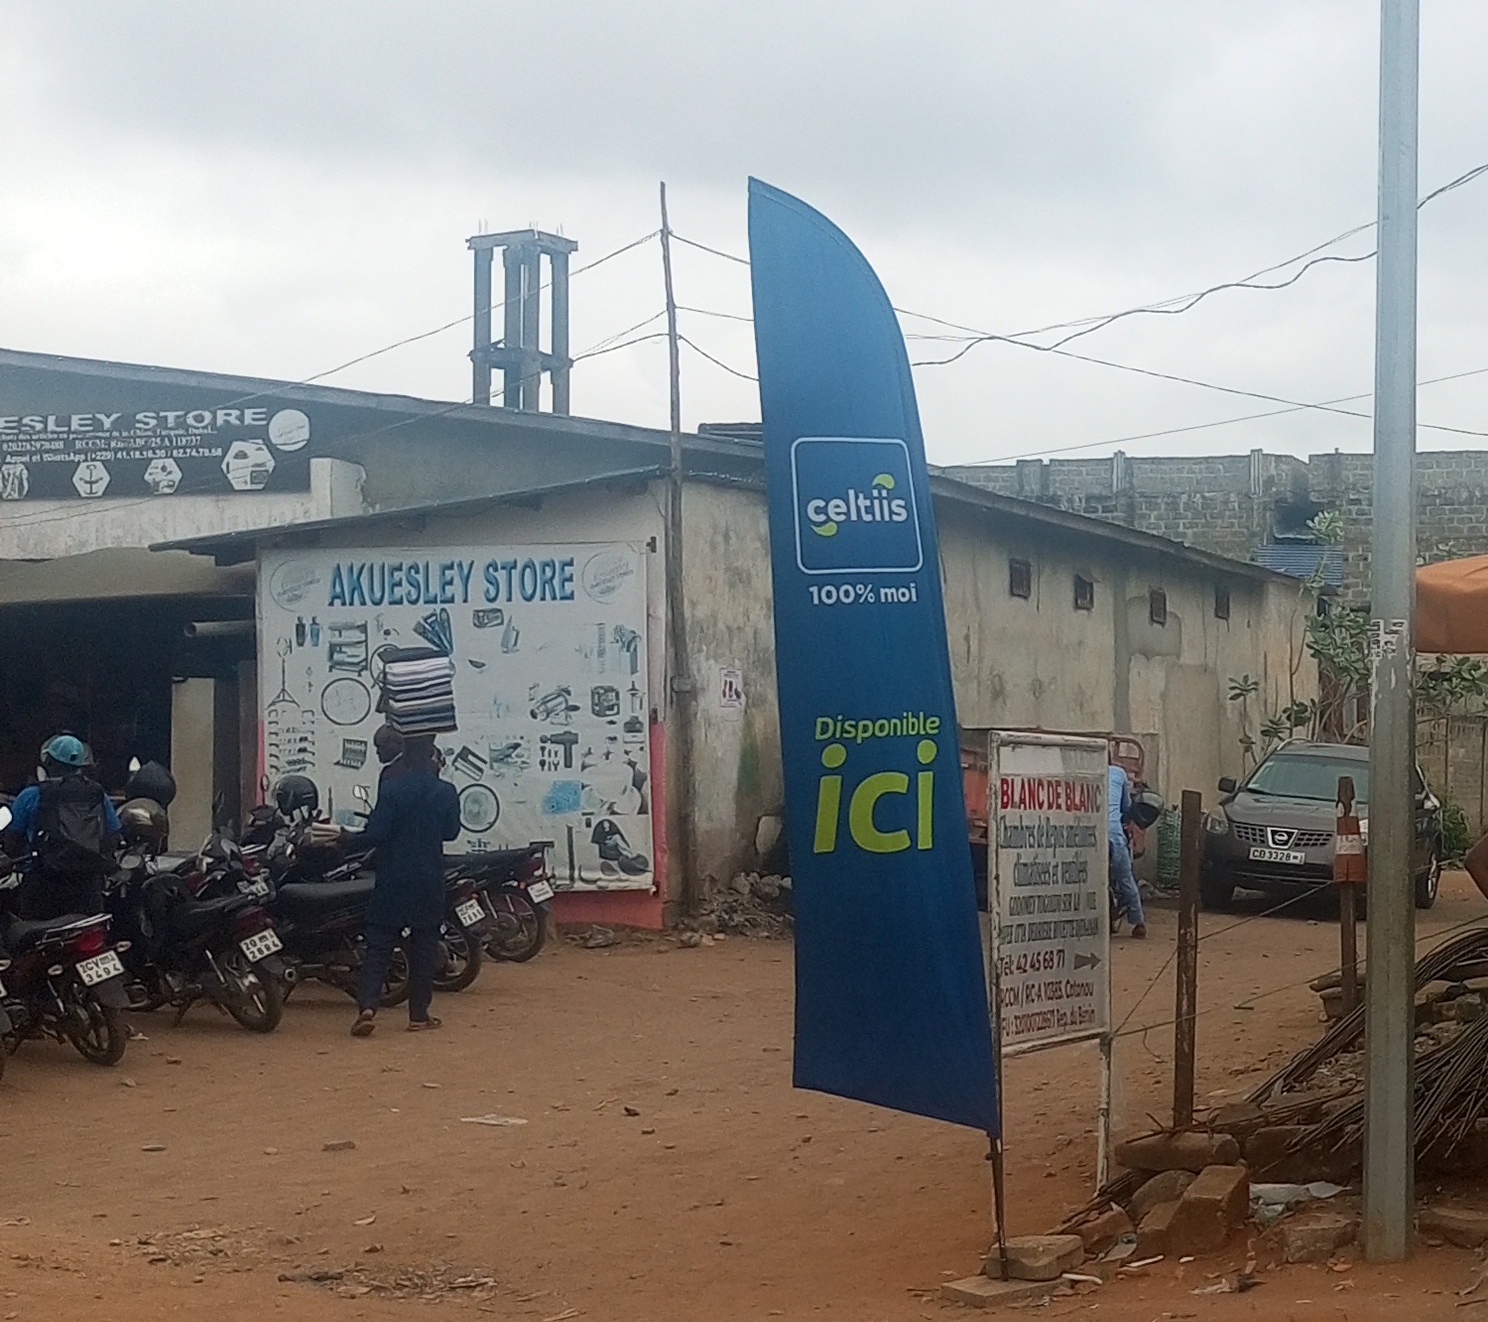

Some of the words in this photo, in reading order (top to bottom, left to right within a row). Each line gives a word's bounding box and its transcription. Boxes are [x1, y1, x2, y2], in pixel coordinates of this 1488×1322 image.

[135, 407, 268, 430] STORE
[806, 481, 909, 525] celtiis
[327, 558, 475, 607] AKUESLEY
[483, 557, 575, 605] STORE
[809, 583, 875, 605] 100%
[879, 580, 918, 604] moi
[815, 711, 941, 744] Disponible
[813, 738, 938, 854] ici
[1000, 777, 1045, 811] BLANC
[1046, 779, 1062, 811] DE
[1064, 781, 1102, 813] BLANC
[1016, 953, 1028, 974] 42
[1030, 952, 1042, 972] 45
[1043, 950, 1054, 970] 68
